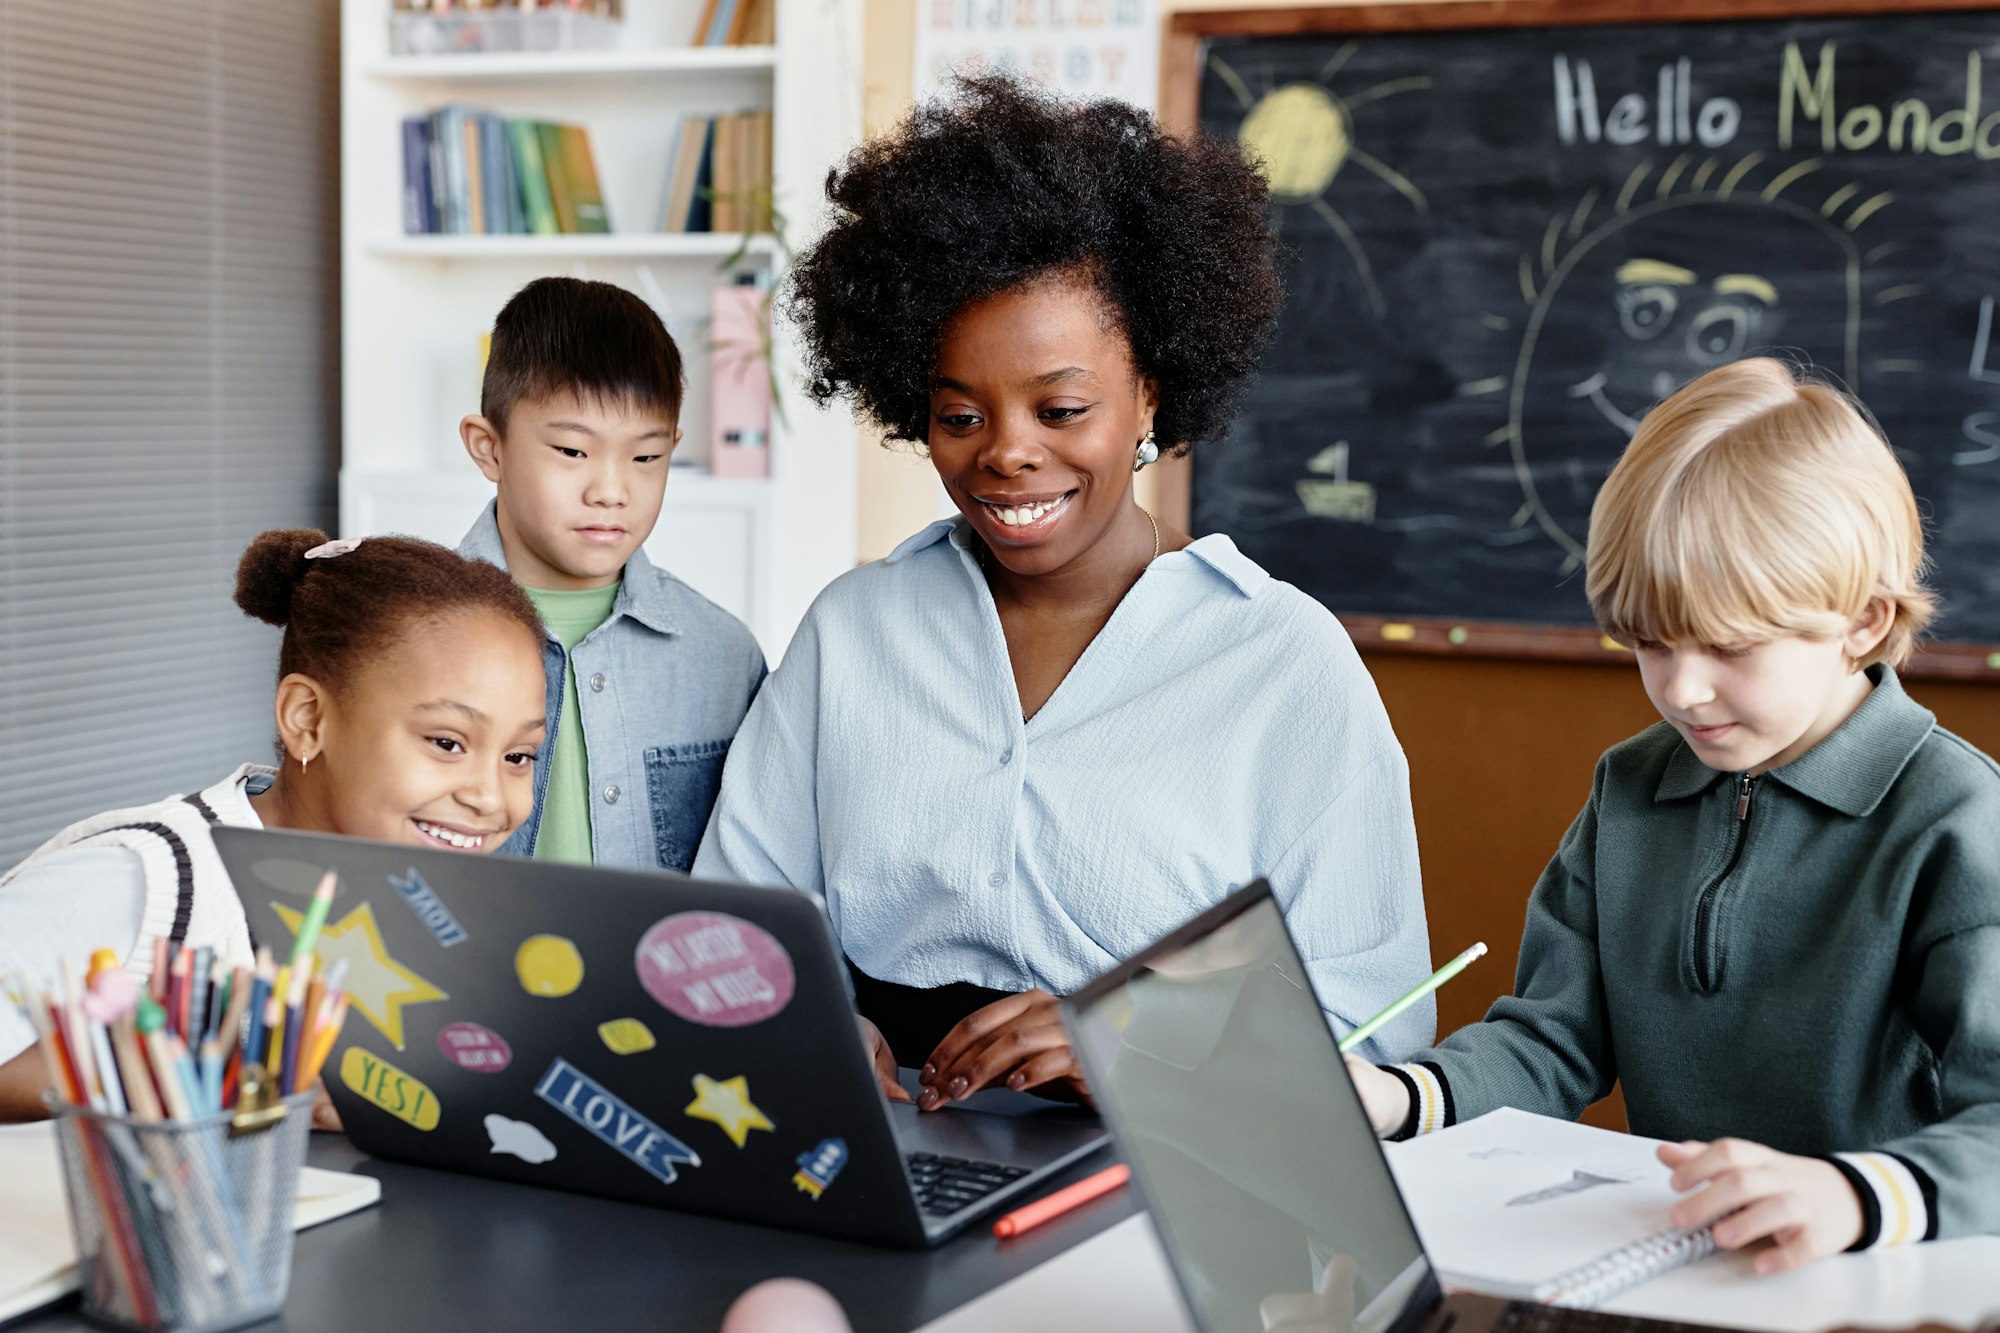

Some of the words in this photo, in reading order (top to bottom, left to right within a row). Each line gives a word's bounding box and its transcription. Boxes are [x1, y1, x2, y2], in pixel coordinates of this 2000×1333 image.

[1553, 52, 1741, 148] Hello
[363, 1056, 426, 1122] YES!
[563, 1079, 664, 1163] LOVE
